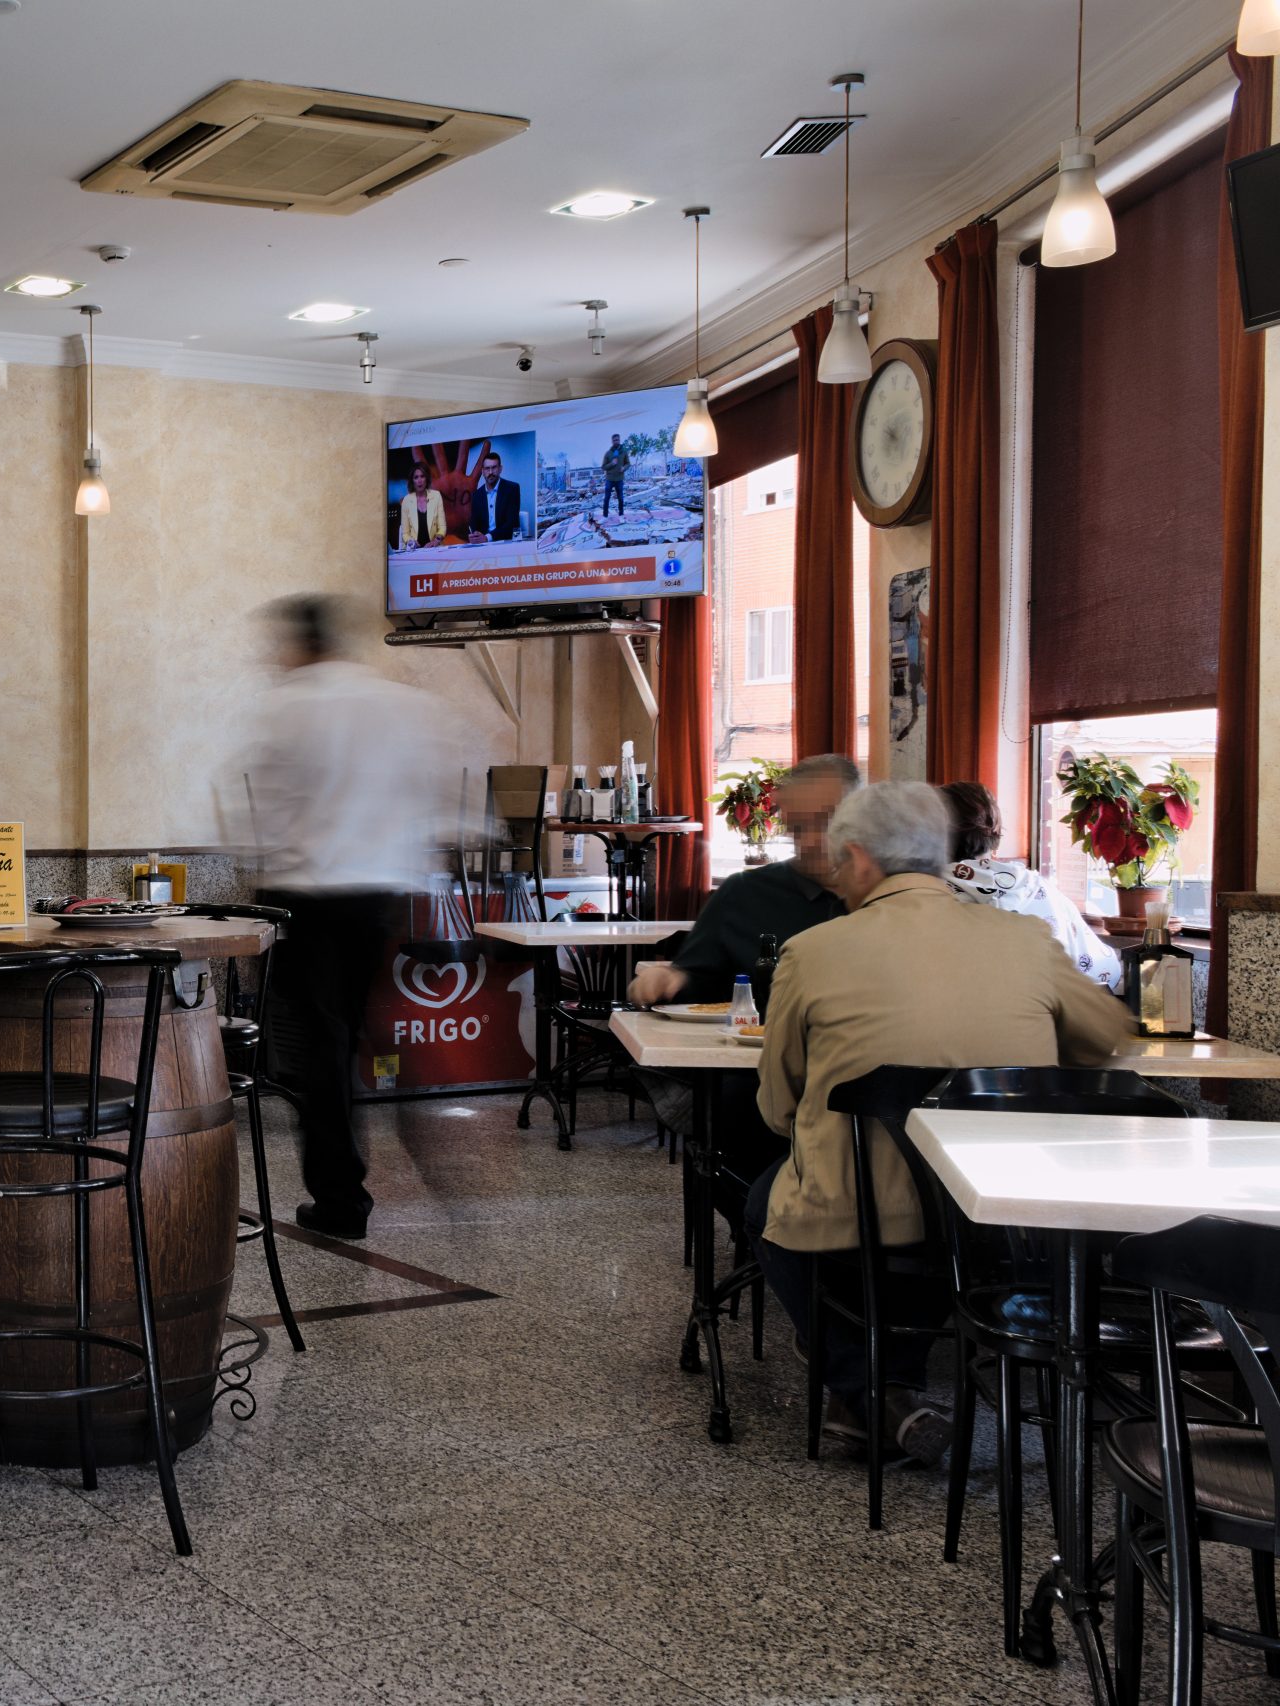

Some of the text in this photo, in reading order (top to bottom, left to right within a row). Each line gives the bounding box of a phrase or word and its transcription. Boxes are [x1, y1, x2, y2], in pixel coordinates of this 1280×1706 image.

[416, 579, 433, 592] LH
[442, 566, 637, 588] A PRISIÓN POR VIOLAR EN GRUPO A UNA JOVEN
[735, 1016, 748, 1025] SAL
[394, 1016, 481, 1045] FRIGO
